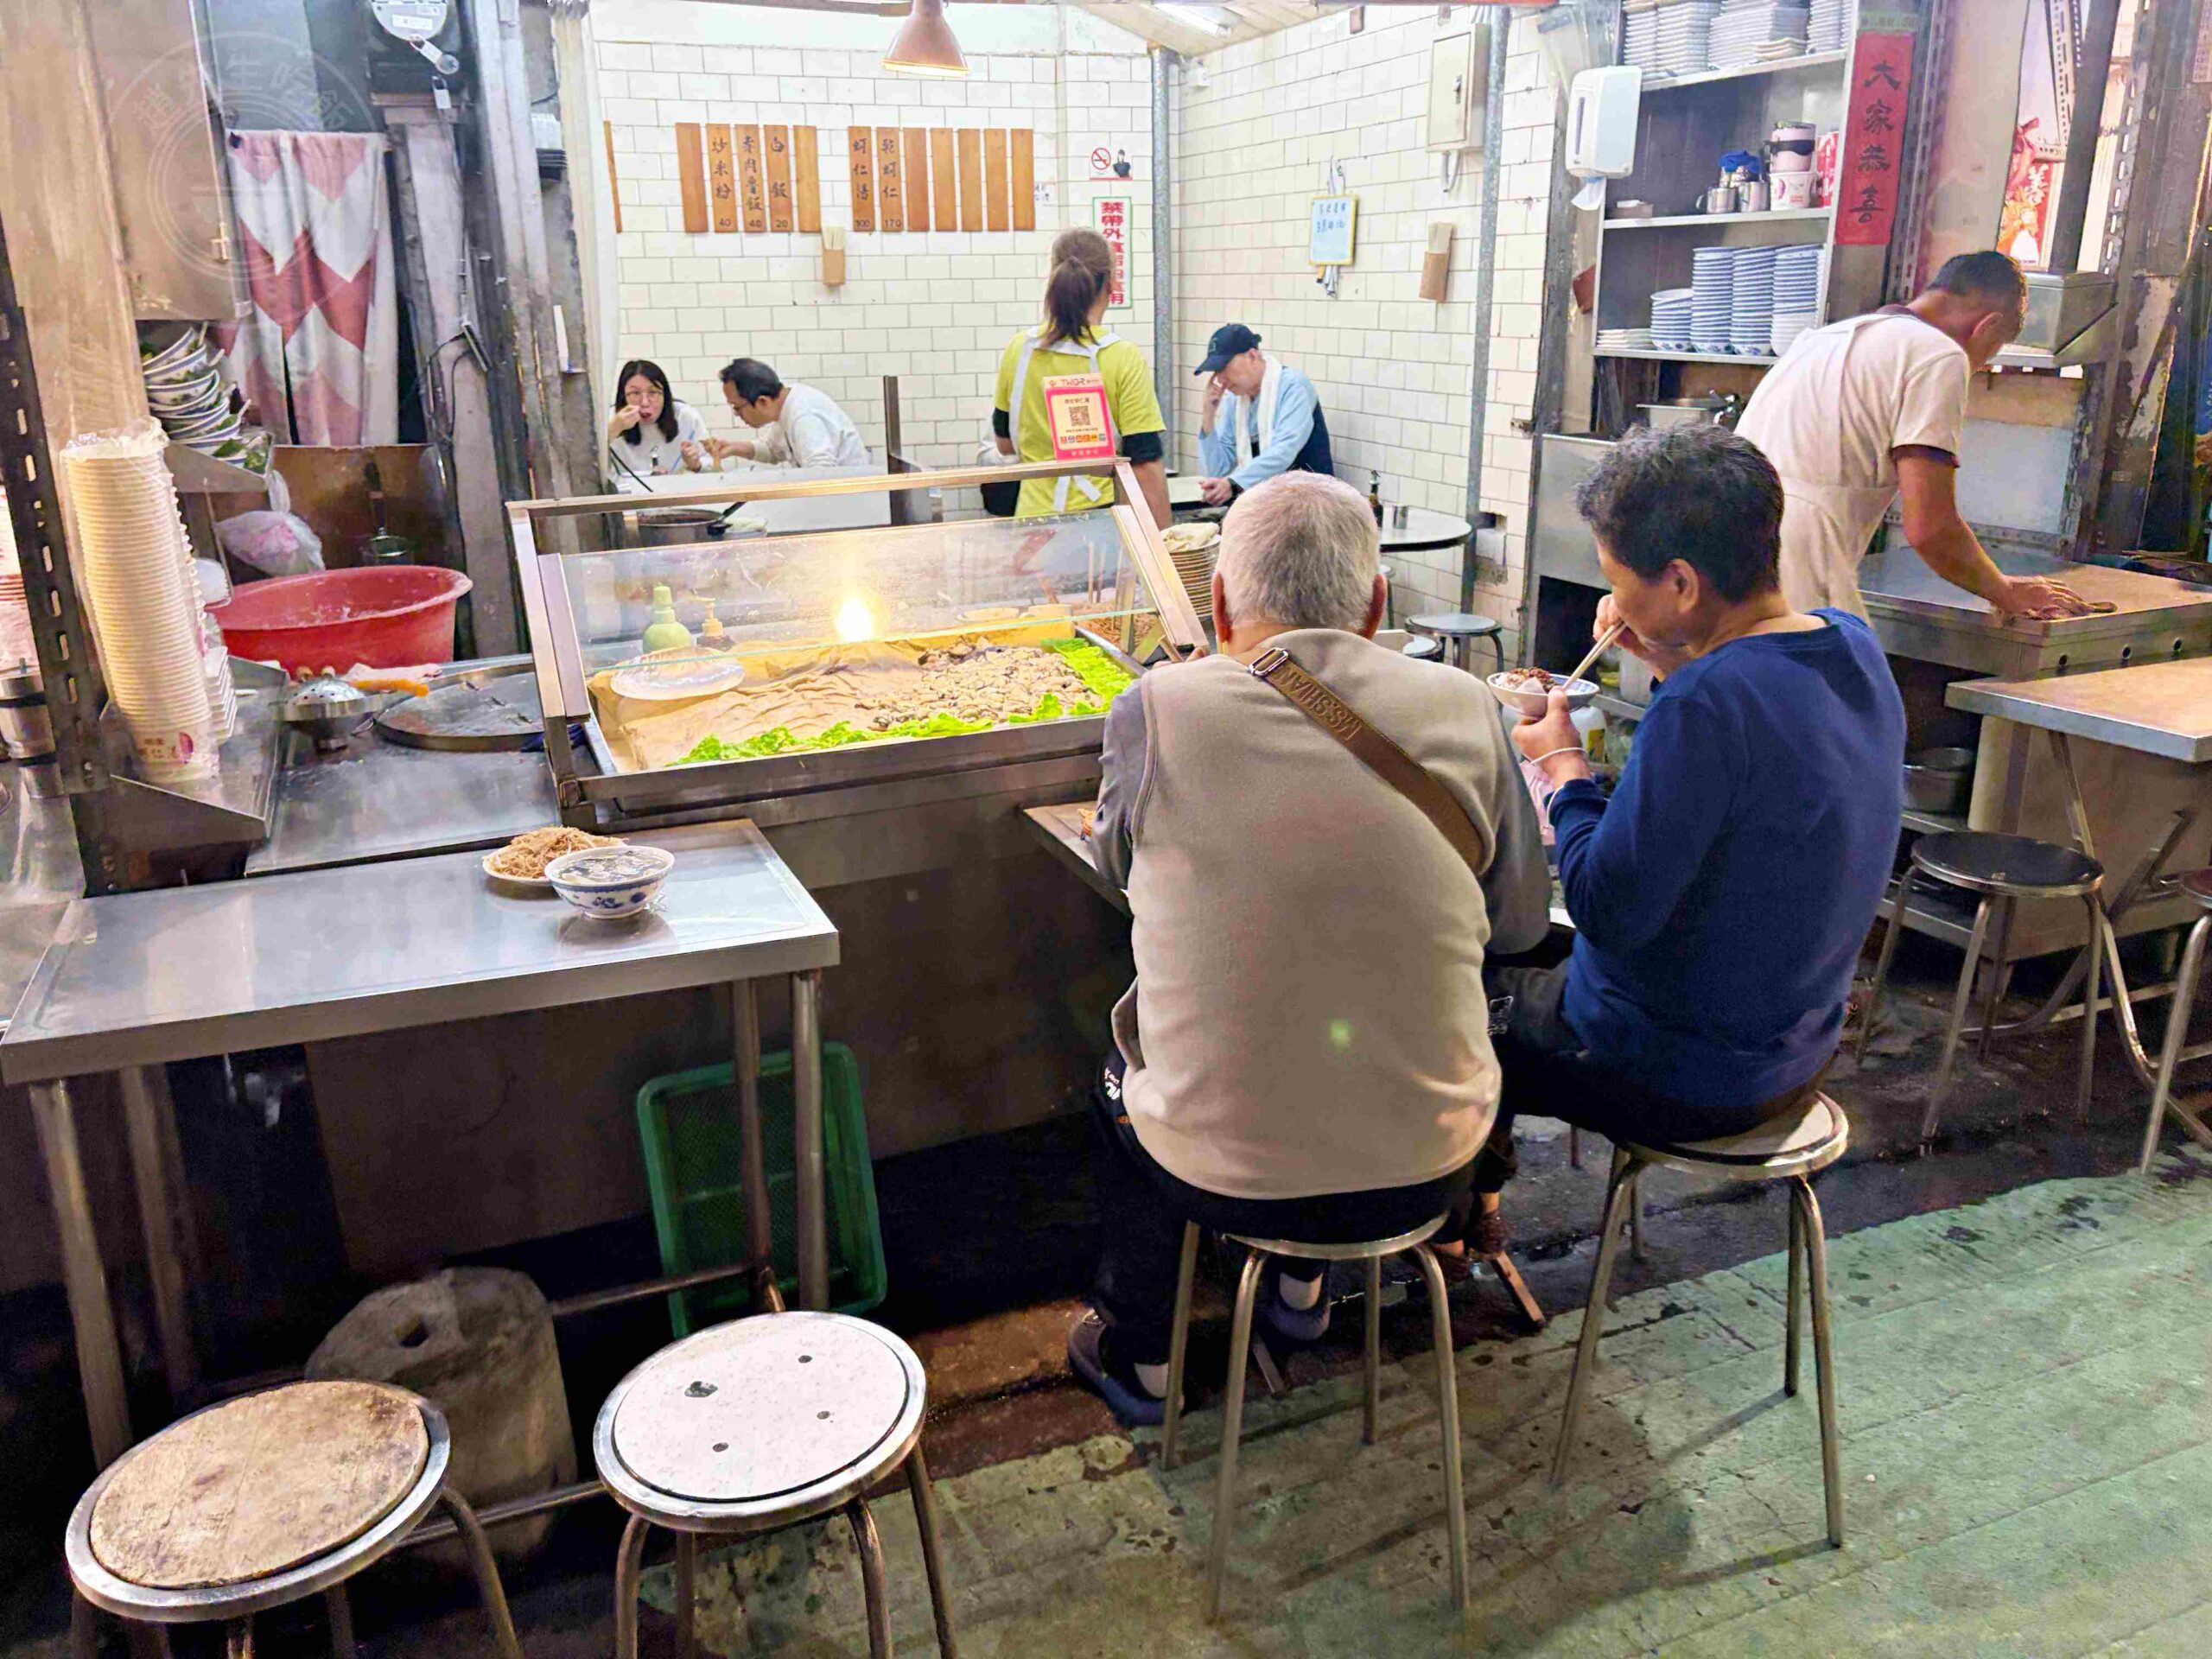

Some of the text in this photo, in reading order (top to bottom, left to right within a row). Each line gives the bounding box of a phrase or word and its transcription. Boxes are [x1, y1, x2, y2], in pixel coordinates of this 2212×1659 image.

[718, 218, 732, 228] 40
[748, 219, 762, 228] 40
[775, 219, 789, 228] 20
[854, 219, 871, 228] 100
[884, 219, 902, 228] 170
